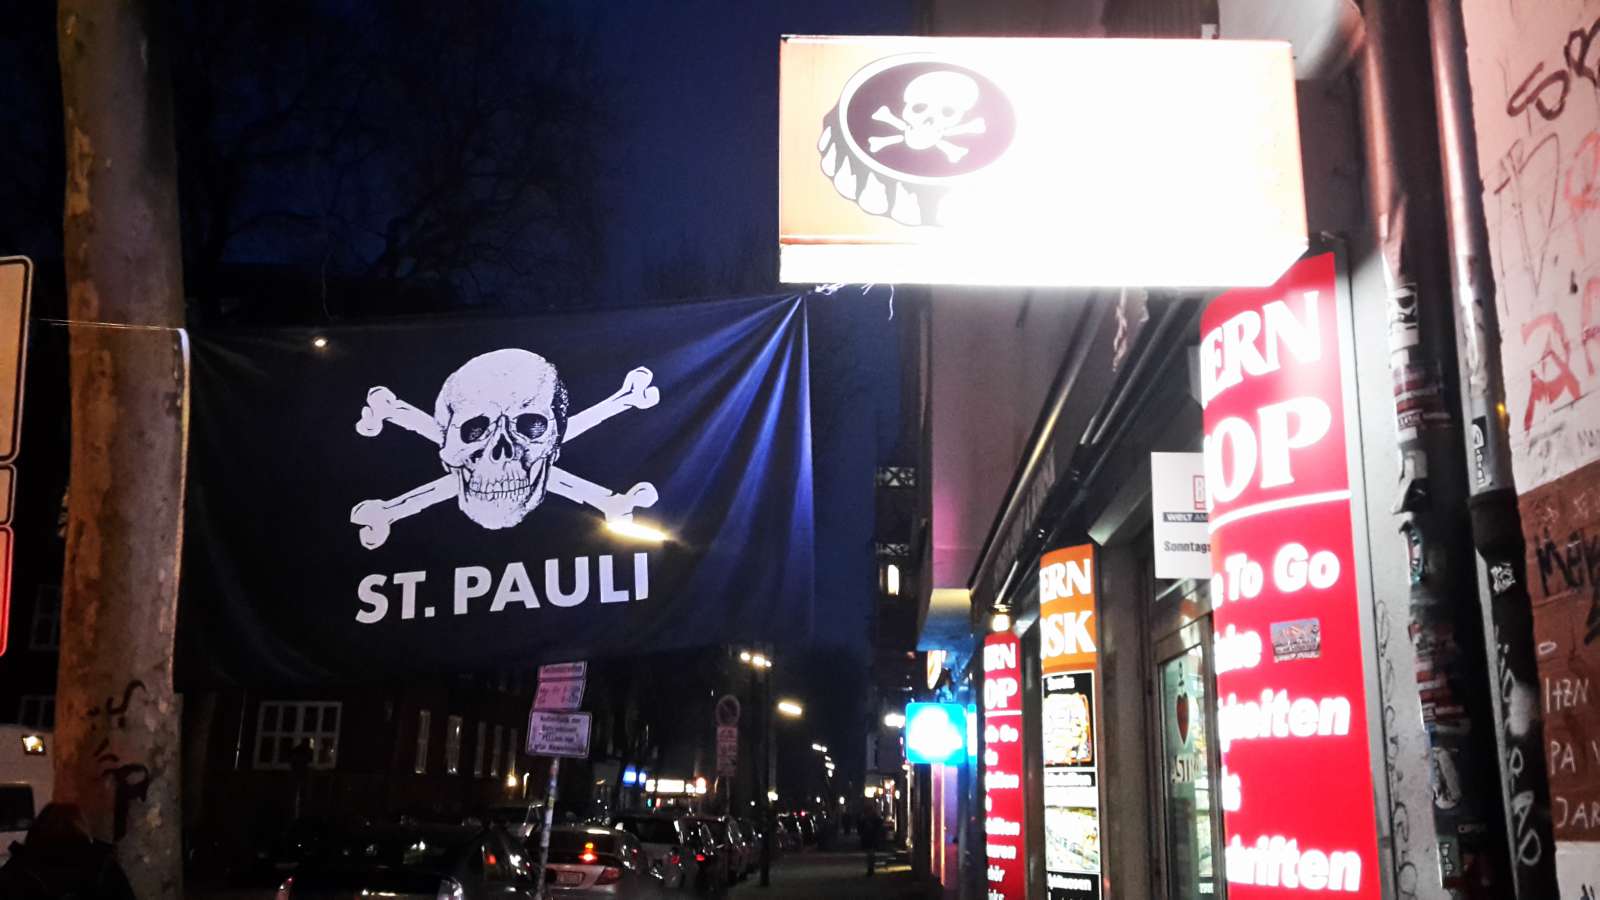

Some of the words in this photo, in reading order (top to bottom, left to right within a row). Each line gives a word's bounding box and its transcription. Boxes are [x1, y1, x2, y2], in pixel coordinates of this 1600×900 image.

[1203, 396, 1332, 514] OP
[355, 570, 435, 625] ST.
[453, 552, 650, 616] PAULI
[1225, 552, 1264, 602] To
[1273, 542, 1341, 593] Go
